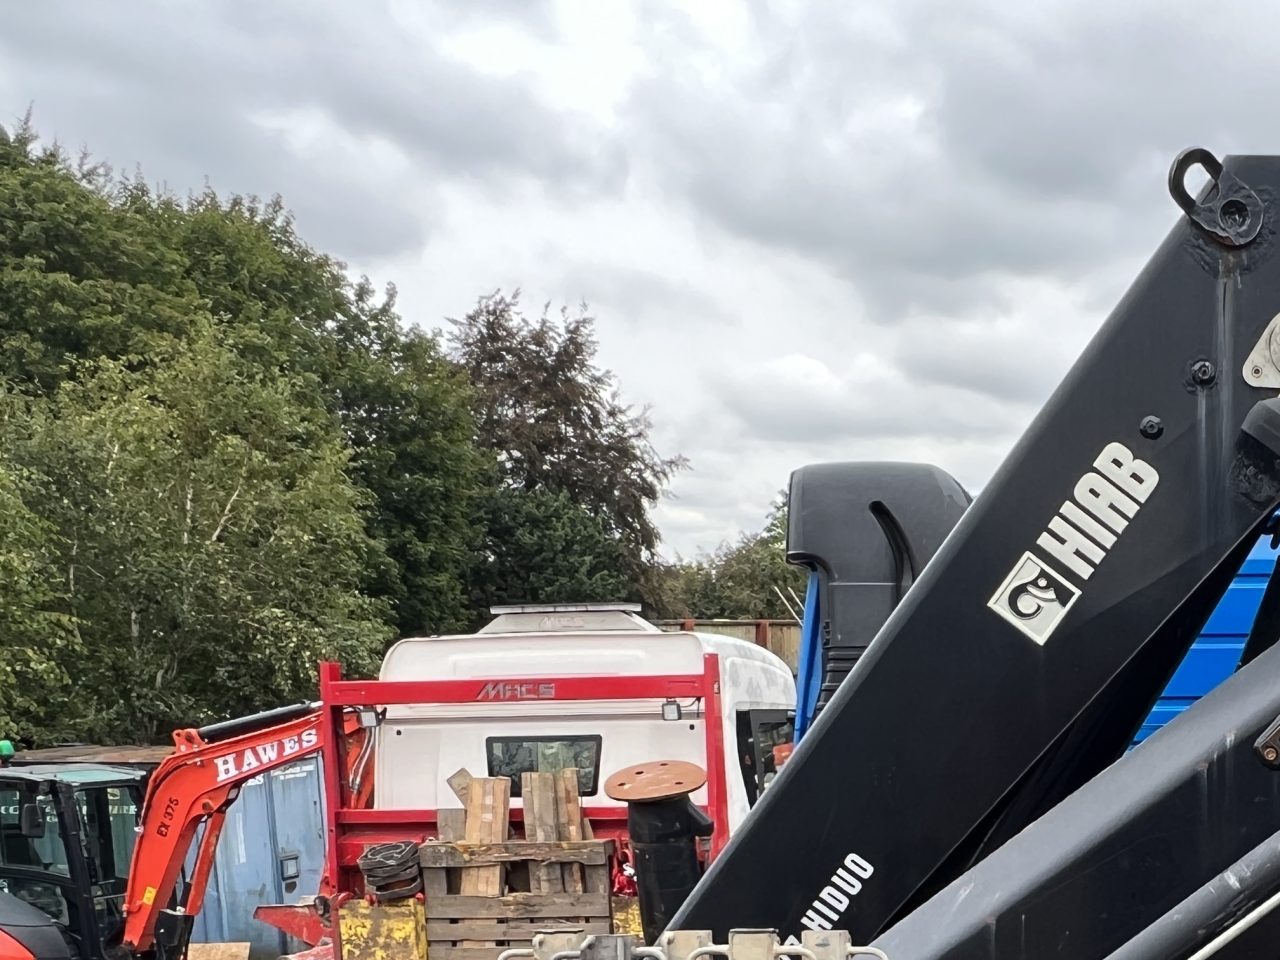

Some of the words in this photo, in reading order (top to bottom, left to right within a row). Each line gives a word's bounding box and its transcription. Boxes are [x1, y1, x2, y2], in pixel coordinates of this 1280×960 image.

[1036, 442, 1159, 580] HIAB
[213, 728, 318, 782] HAWES
[800, 852, 875, 931] HIDUO
